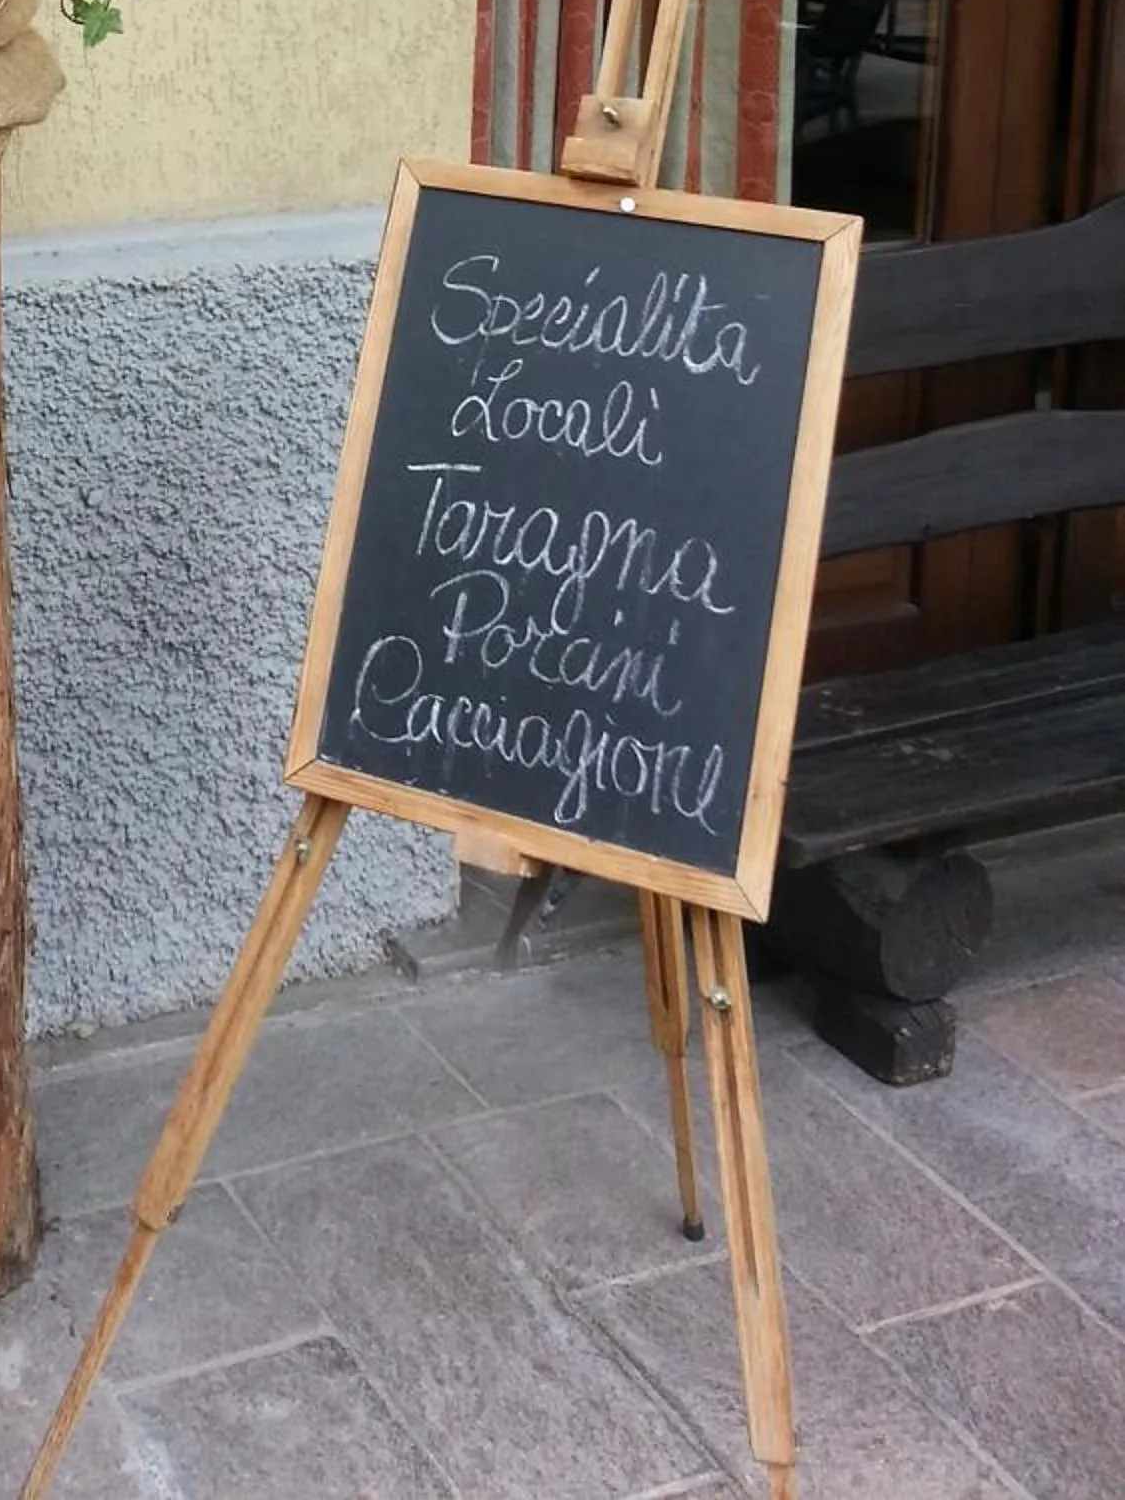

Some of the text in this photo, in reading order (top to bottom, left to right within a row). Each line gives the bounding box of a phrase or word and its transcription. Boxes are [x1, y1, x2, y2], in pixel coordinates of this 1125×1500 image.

[451, 358, 663, 465] Locali
[407, 463, 736, 636] Taragna
[429, 569, 682, 716] Porcini
[349, 634, 725, 836] Cacciagione
